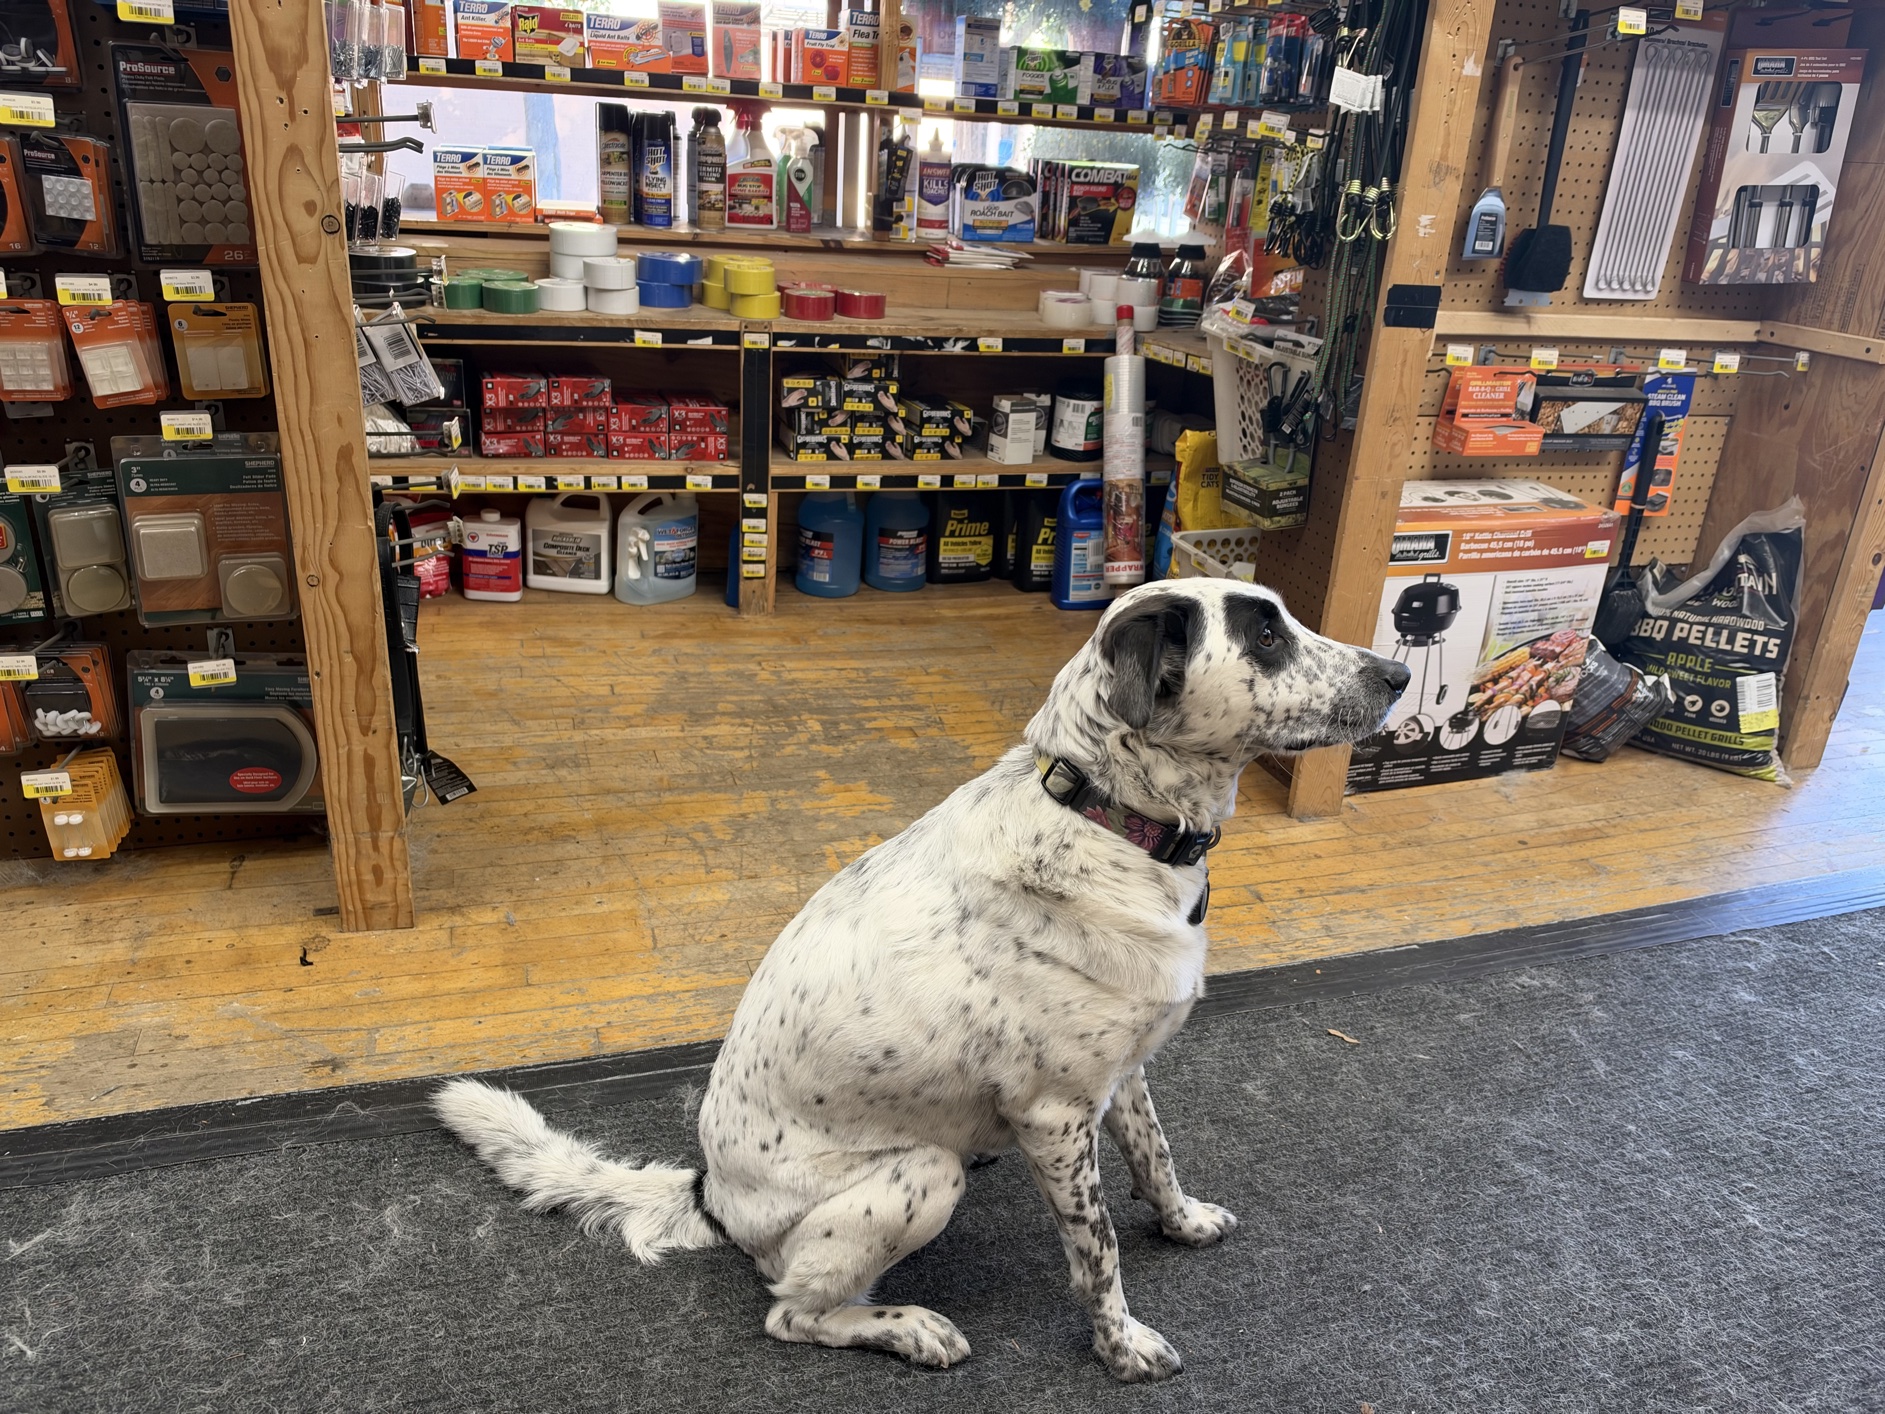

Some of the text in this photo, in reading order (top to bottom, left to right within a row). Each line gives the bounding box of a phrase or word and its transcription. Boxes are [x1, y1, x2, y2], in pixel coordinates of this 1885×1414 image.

[459, 1, 488, 16] TERRO
[471, 17, 487, 25] Killer
[519, 16, 539, 31] Raid
[591, 16, 622, 31] TERRO
[852, 13, 880, 27] TERRO
[590, 33, 606, 42] Liquid
[808, 30, 827, 40] TERRO
[853, 28, 868, 40] Flea
[1169, 40, 1197, 49] GORILLA
[119, 61, 176, 75] ProSource
[1021, 72, 1045, 80] FOGGER
[23, 149, 56, 160] ProSource
[646, 147, 665, 156] HOT
[436, 152, 462, 164] TERRO
[486, 155, 512, 165] TERRO
[645, 155, 667, 166] SHOT
[698, 165, 722, 173] ERMITE
[645, 175, 667, 184] FLYING
[975, 170, 995, 181] HOT
[1071, 168, 1128, 184] COMBAT
[645, 180, 667, 189] INSECT
[923, 178, 949, 188] KILLS
[972, 179, 999, 192] SHOT
[923, 187, 949, 196] ROACHES
[970, 209, 1014, 218] ROACH BAIT
[224, 250, 244, 261] 26
[73, 323, 82, 331] 12
[486, 392, 496, 407] X3
[552, 392, 561, 405] X3
[1472, 392, 1505, 400] CLEANER
[1647, 393, 1667, 401] STEAM
[673, 410, 686, 419] X3
[610, 417, 619, 430] X3
[484, 437, 498, 447] X3
[549, 433, 561, 443] X3
[611, 435, 624, 445] X3
[1201, 473, 1219, 481] TIDY
[135, 480, 141, 488] 4
[1200, 480, 1220, 489] CATS
[1283, 489, 1297, 497] PACK
[1271, 496, 1304, 506] ADJUSTABLE
[1276, 501, 1299, 510] BUNGEES
[944, 519, 990, 537] Prime
[1474, 531, 1492, 539] Kettle
[1492, 530, 1519, 538] Charcoal
[1519, 529, 1533, 537] Grill
[888, 538, 910, 546] POWER
[1460, 542, 1488, 550] Barbecue
[1489, 541, 1503, 549] 45,5
[1513, 540, 1524, 549] (18
[1524, 539, 1535, 549] po)
[487, 543, 509, 555] TSP
[543, 542, 591, 553] COMPOSITE DECK
[1458, 551, 1481, 560] Parrilla
[1481, 551, 1512, 559] americana
[1512, 550, 1521, 558] de
[1541, 548, 1549, 556] de
[1549, 547, 1563, 555] 45.5
[1737, 572, 1777, 595] TAIN
[1651, 606, 1765, 631] 00% NATURAL HARDWOOD
[1631, 617, 1783, 660] BBQ PELLETS
[1666, 652, 1714, 673] APPLE
[1646, 663, 1732, 689] MILD SWEET FLAVOR
[1685, 711, 1697, 719] PORK
[1642, 734, 1655, 744] USA
[1674, 725, 1709, 741] PELLET
[1710, 732, 1745, 747] GRILLS
[1671, 743, 1685, 752] NET
[1685, 745, 1697, 755] WT.
[1698, 748, 1706, 757] 20
[1706, 750, 1720, 759] LBS
